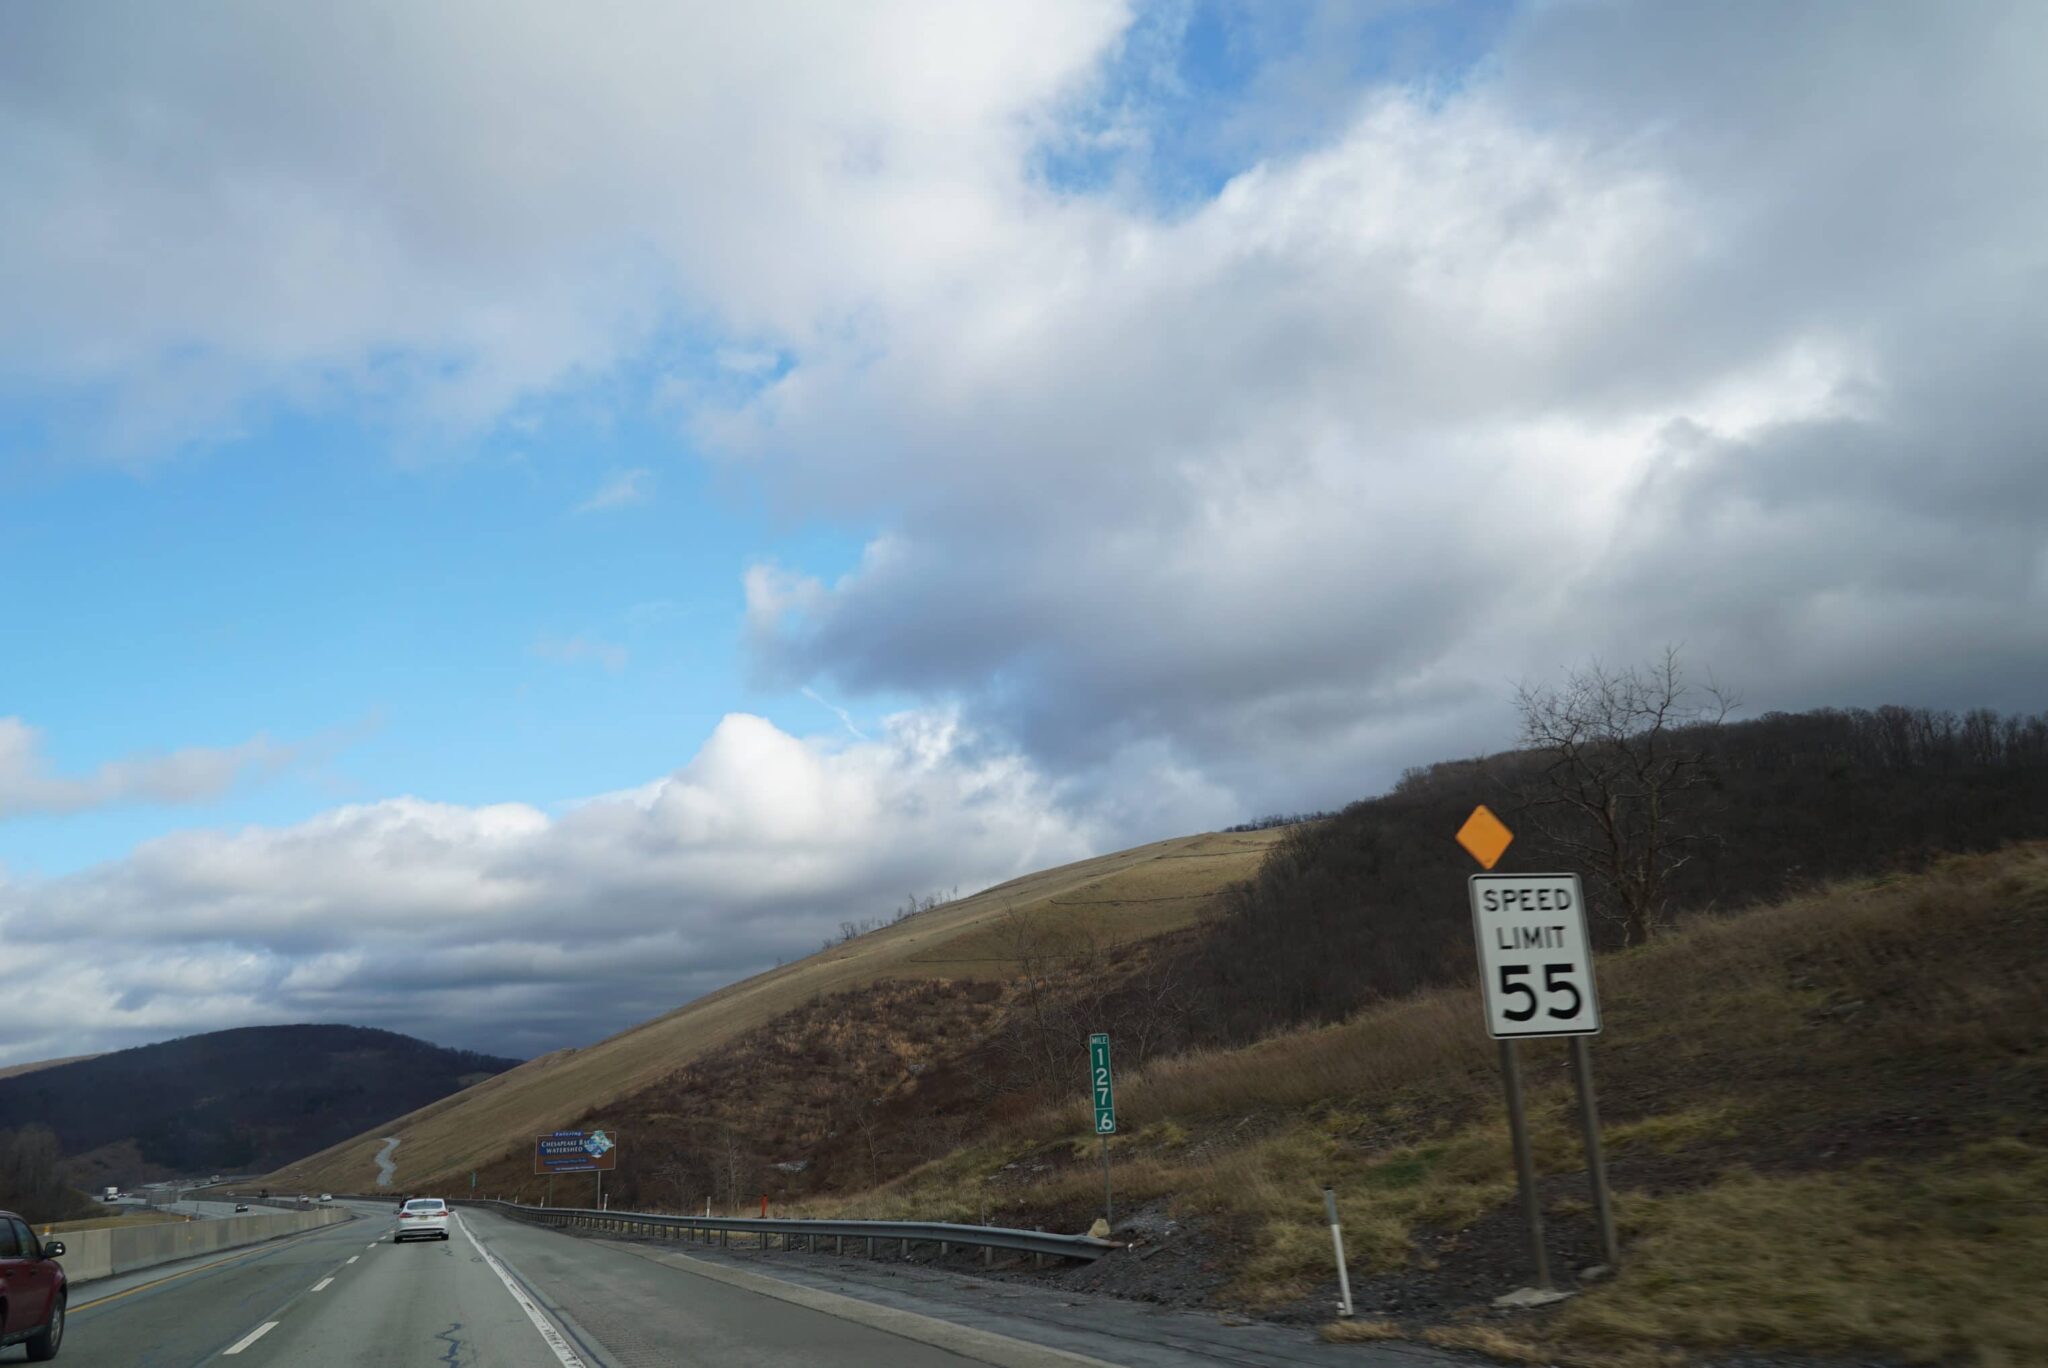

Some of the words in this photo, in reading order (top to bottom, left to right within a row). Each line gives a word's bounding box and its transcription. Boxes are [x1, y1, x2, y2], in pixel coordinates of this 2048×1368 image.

[1483, 888, 1572, 912] SPEED
[1496, 925, 1566, 949] LIMIT
[1499, 963, 1582, 1022] 55
[1091, 1035, 1108, 1045] MILE
[546, 1146, 583, 1154] WATERSHED
